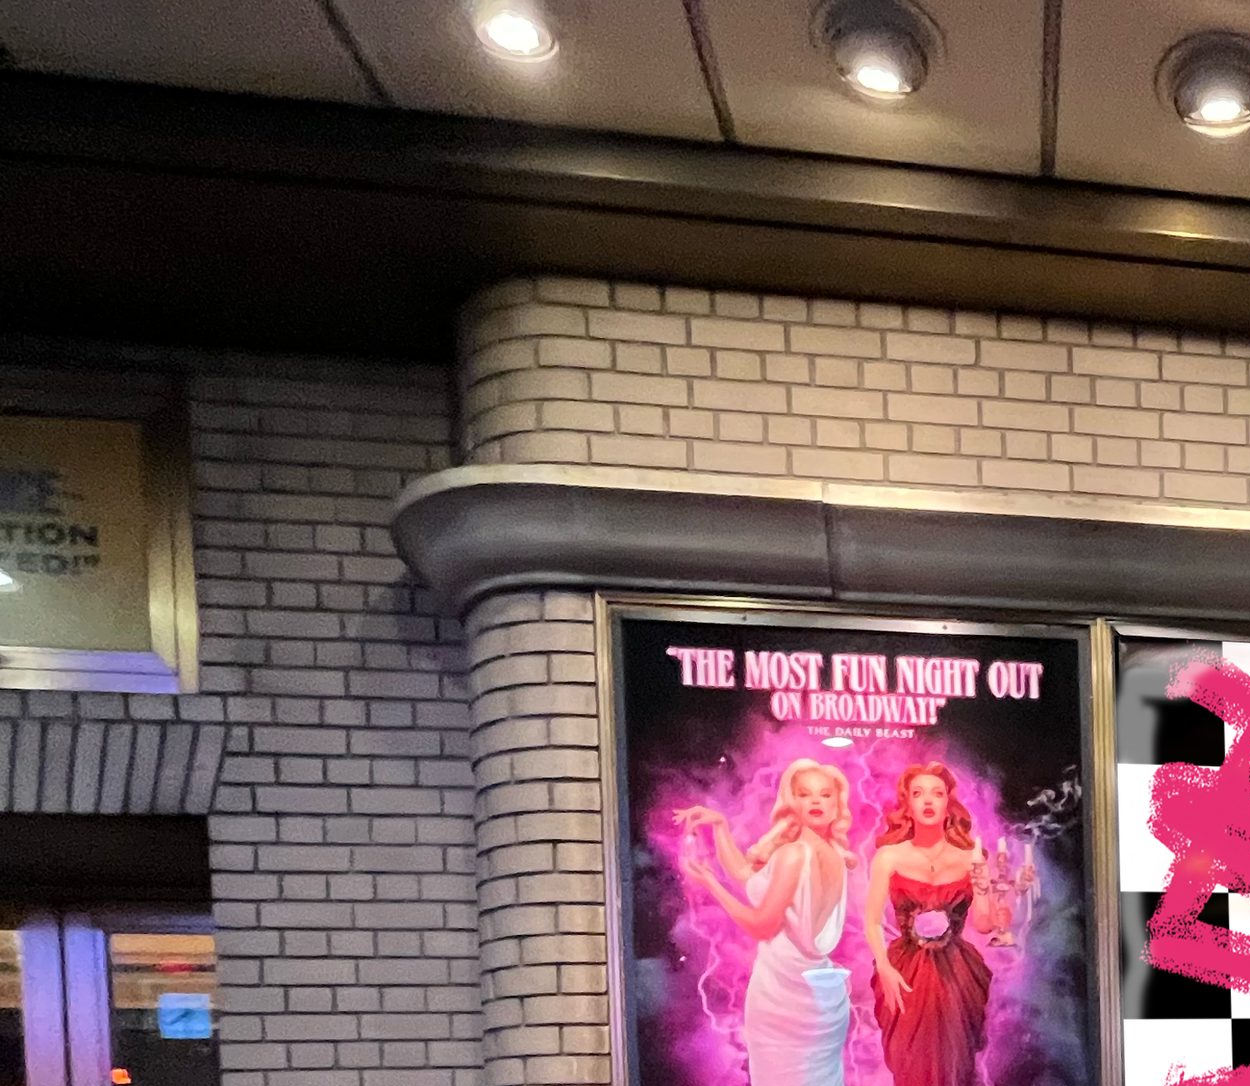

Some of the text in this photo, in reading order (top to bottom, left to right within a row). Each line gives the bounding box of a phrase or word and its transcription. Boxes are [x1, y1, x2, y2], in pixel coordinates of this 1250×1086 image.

[744, 650, 823, 691] MOST
[832, 653, 888, 695] FUN
[896, 655, 980, 697] NIGHT
[987, 660, 1044, 699] OUT
[770, 691, 801, 721] ON
[806, 726, 915, 739] THE DAILY BEAST
